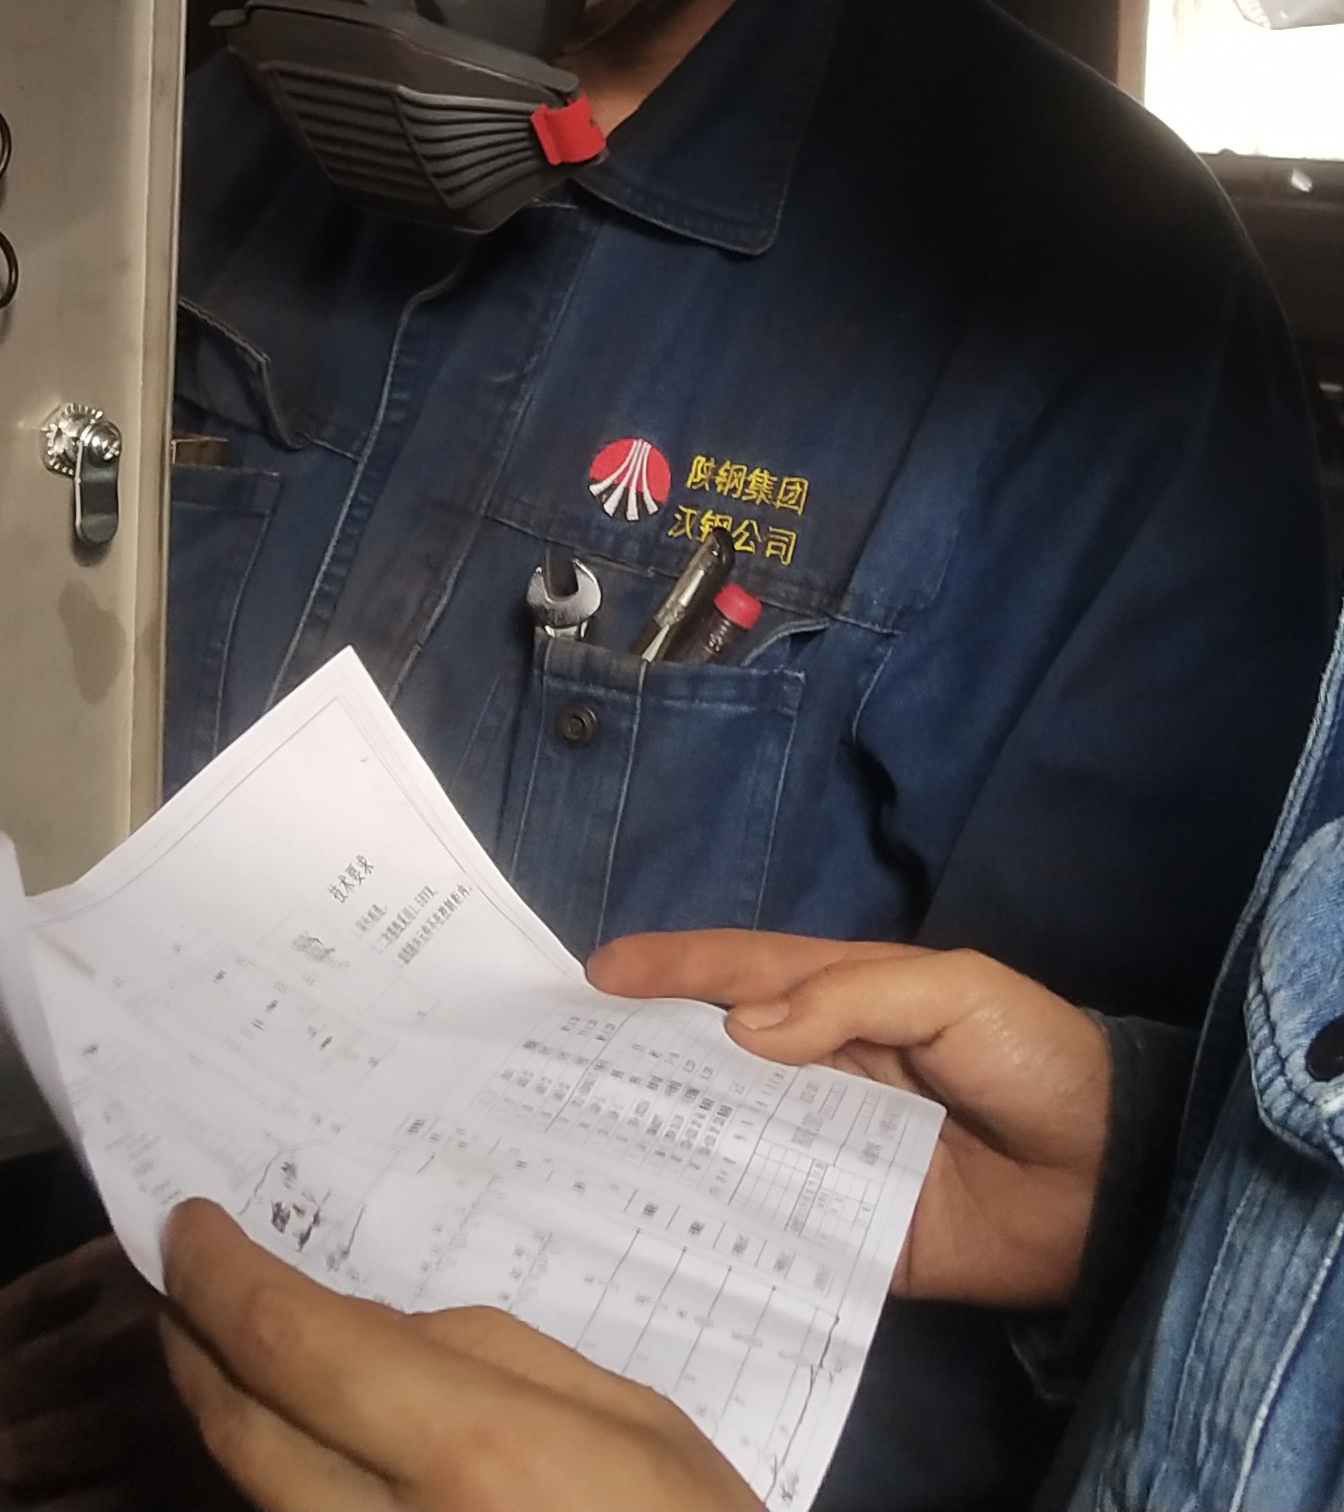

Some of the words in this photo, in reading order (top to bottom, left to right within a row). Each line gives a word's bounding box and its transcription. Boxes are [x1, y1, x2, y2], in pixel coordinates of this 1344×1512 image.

[686, 455, 809, 516] 陕钢集团
[667, 504, 797, 566] 汉钢公司
[327, 854, 375, 904] 技术要求
